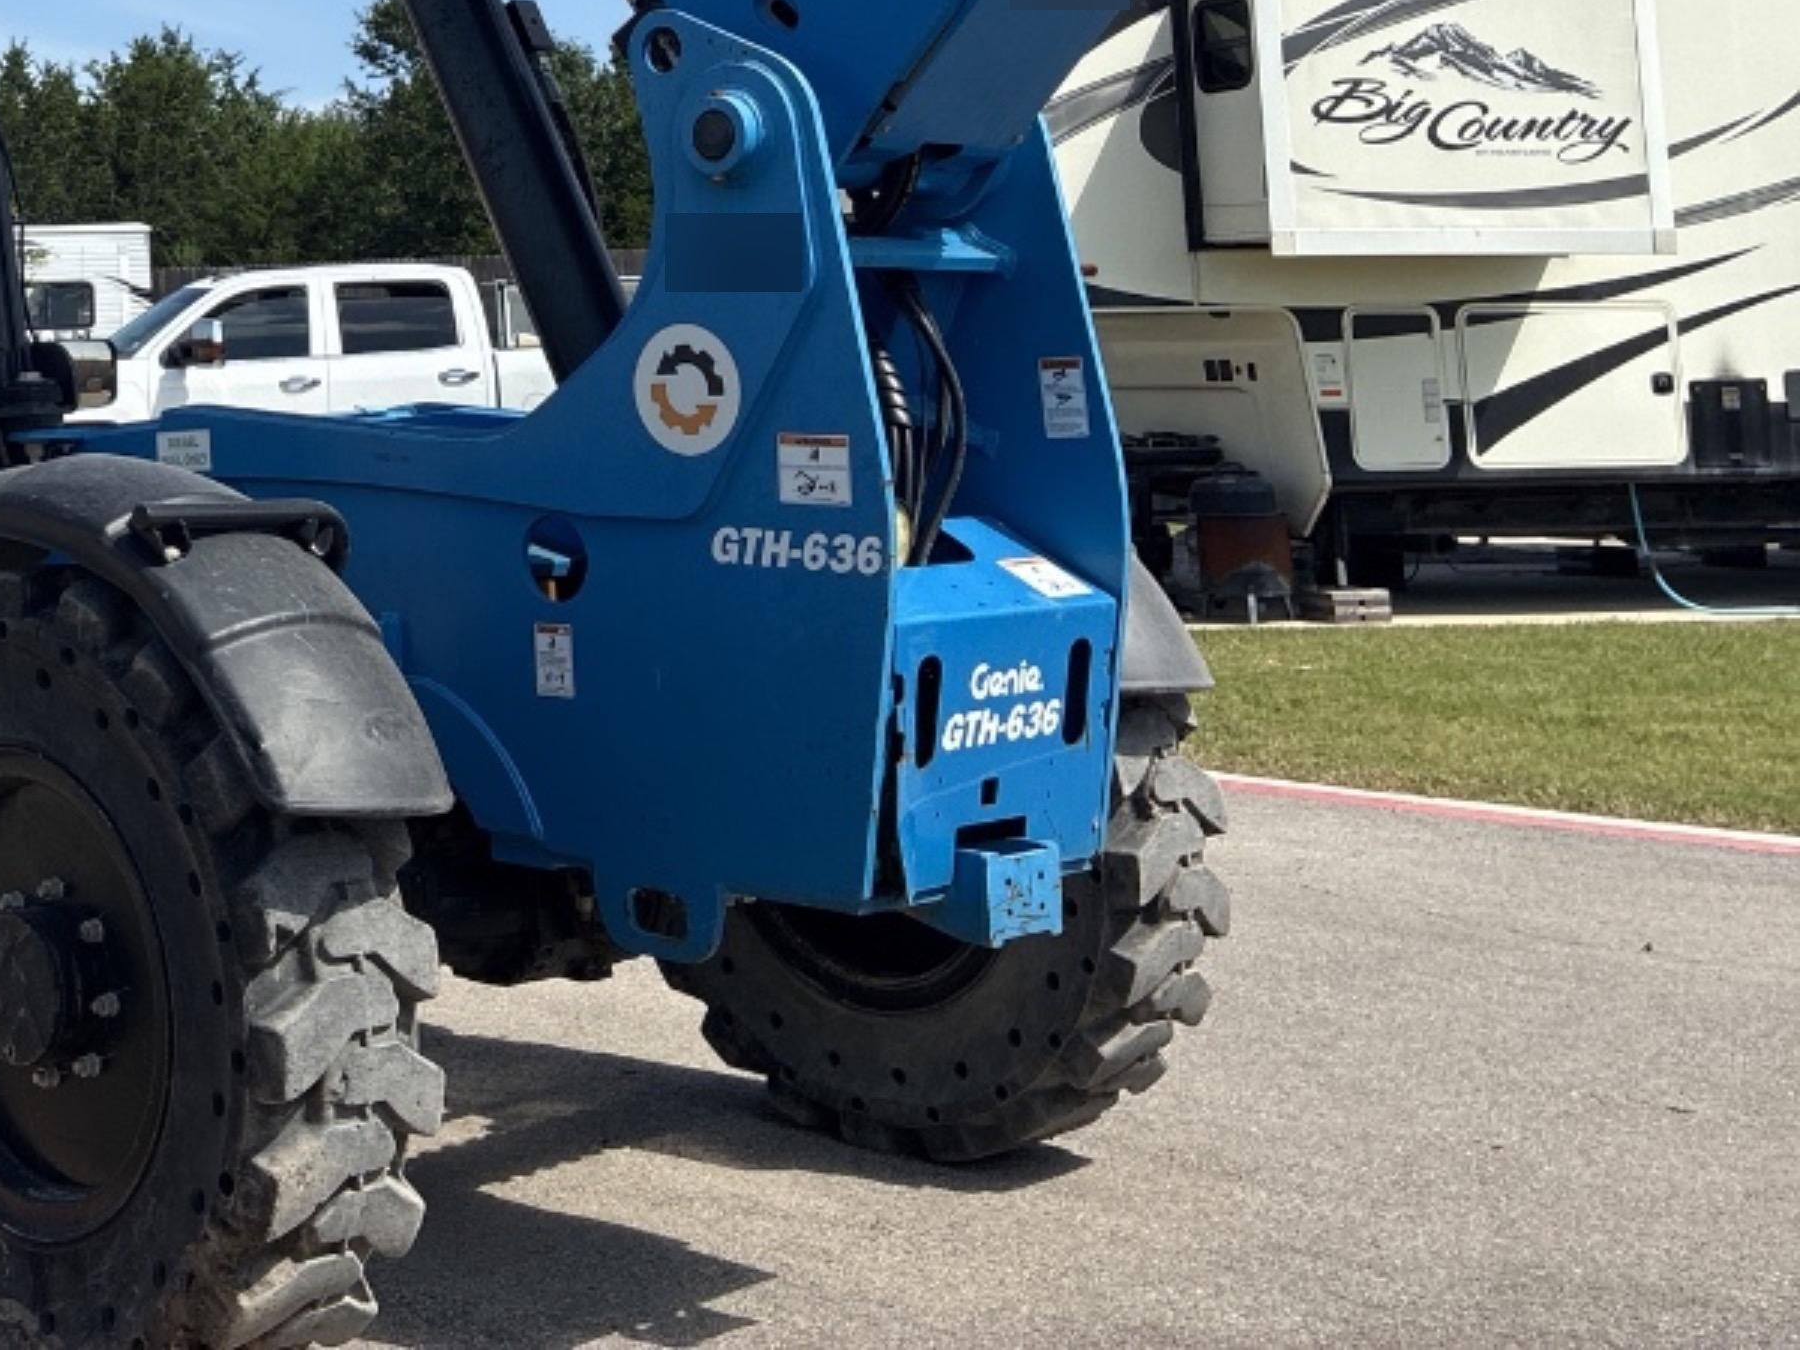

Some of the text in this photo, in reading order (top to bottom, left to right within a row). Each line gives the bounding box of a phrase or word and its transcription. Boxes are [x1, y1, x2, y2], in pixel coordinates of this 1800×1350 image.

[1311, 77, 1632, 164] Big Country
[712, 526, 883, 576] GTH-636
[971, 659, 1044, 700] Genie
[941, 698, 1061, 751] GTH-636
